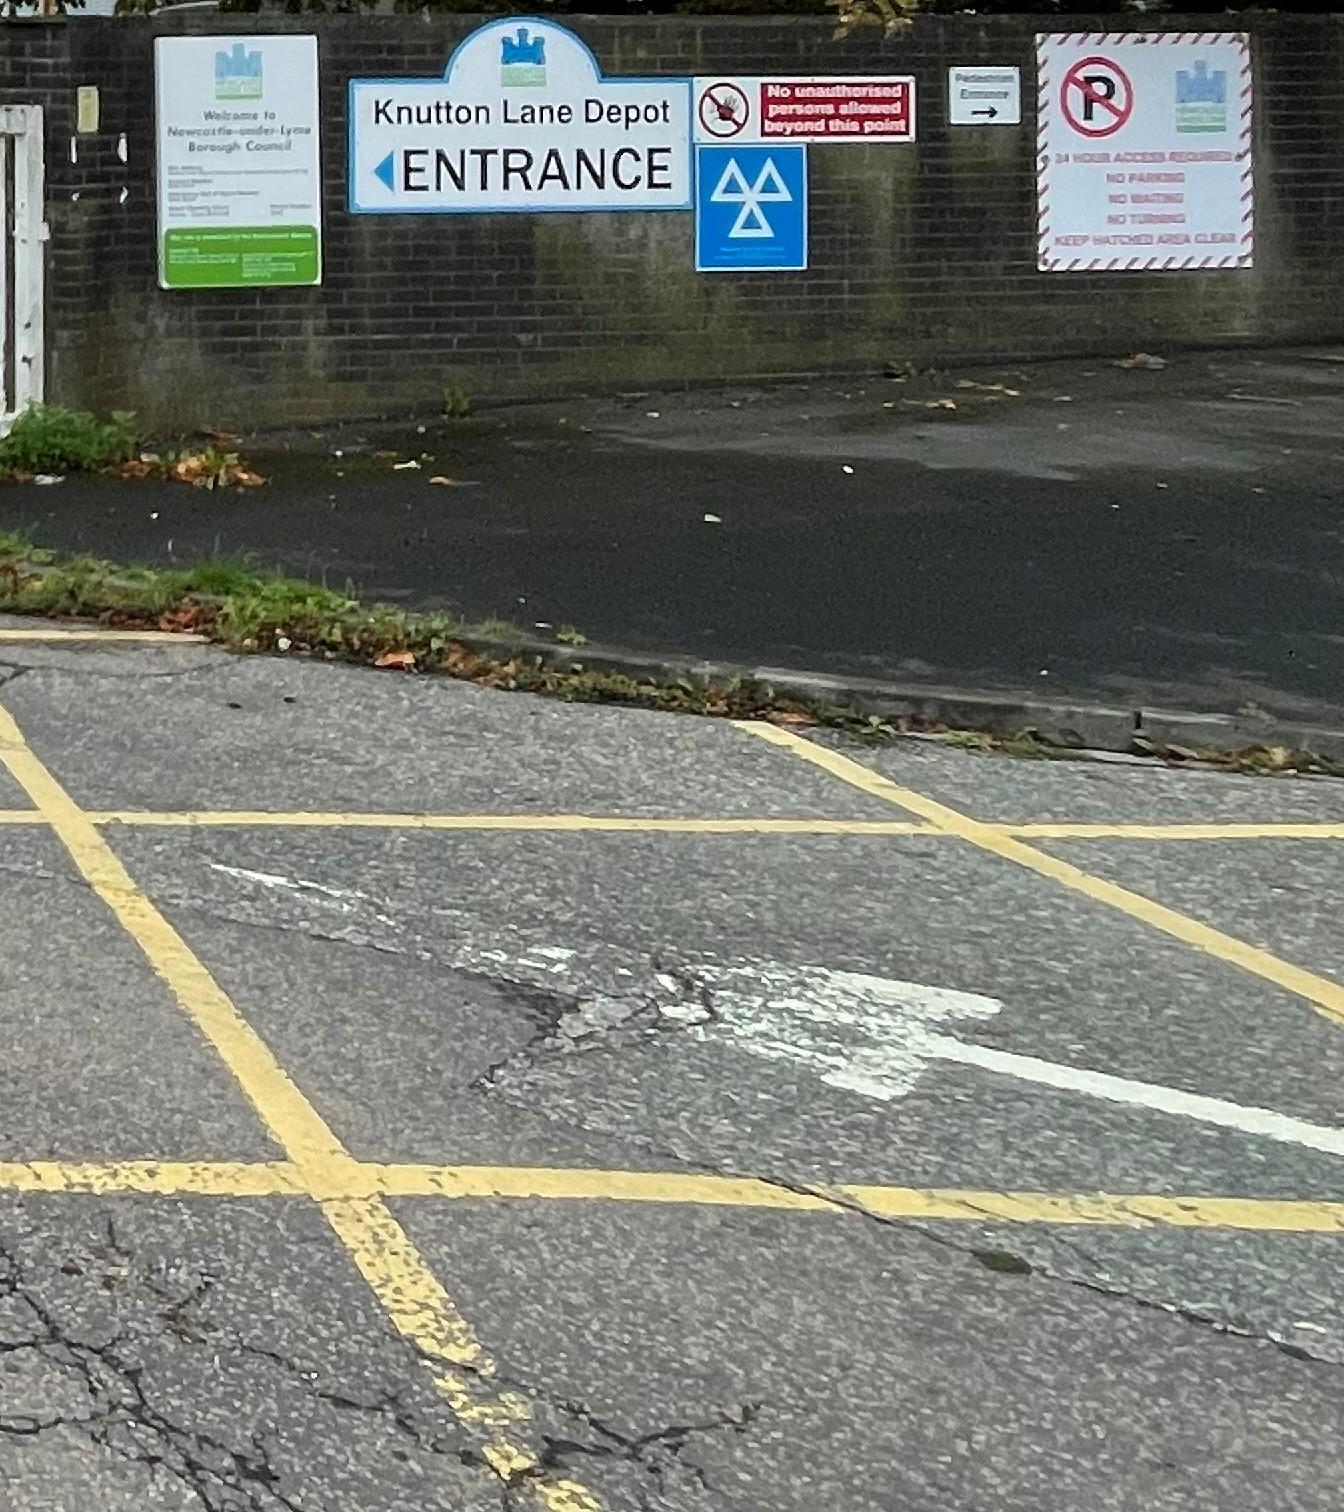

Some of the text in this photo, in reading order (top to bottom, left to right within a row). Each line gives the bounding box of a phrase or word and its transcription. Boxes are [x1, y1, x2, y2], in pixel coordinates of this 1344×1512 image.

[767, 85, 903, 98] No unauthorised
[1083, 75, 1116, 121] P
[203, 110, 277, 121] Welcome to
[373, 98, 670, 130] Knutton Lane Depot
[768, 101, 902, 117] persons allowed
[764, 118, 907, 135] beyond this point
[188, 140, 293, 154] Borough Council
[1073, 153, 1110, 163] HOUR
[1114, 152, 1166, 163] ACCESS
[403, 147, 672, 191] ENTRANCE
[1107, 173, 1185, 183] NO PARKING
[1109, 194, 1127, 203] NO
[1107, 215, 1126, 224] NO
[1055, 236, 1090, 246] KEEP
[1157, 234, 1191, 244] AREA
[1195, 233, 1236, 243] CLEAR
